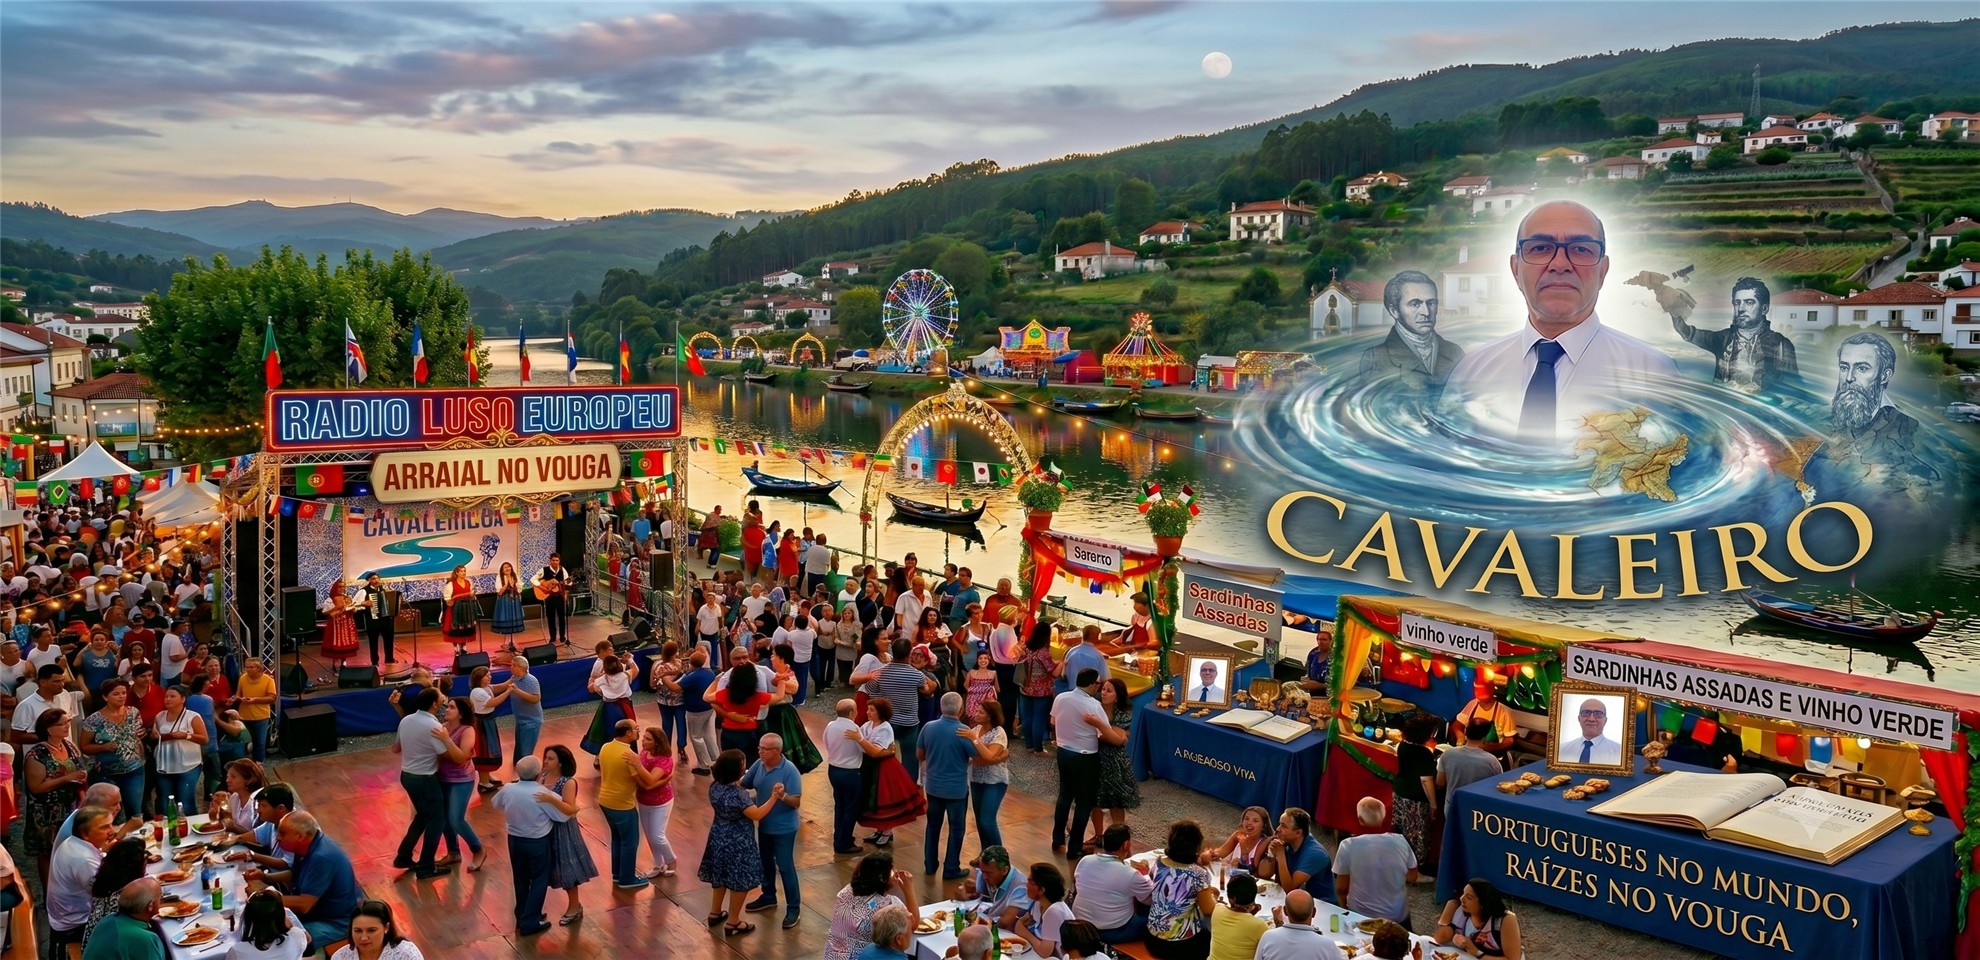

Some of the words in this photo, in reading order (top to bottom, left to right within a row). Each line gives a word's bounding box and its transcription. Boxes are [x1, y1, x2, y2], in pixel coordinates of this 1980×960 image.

[282, 398, 409, 440] RADIO
[422, 396, 515, 435] LUSO
[522, 394, 671, 432] EUROPEU
[384, 459, 491, 491] ARRAIAL
[498, 457, 529, 484] NO
[536, 453, 612, 482] VOUGA
[1189, 582, 1276, 615] Sardinhas
[1194, 601, 1268, 633] Assadas
[1406, 622, 1445, 644] vinho
[1448, 635, 1488, 653] verde
[1573, 654, 1677, 691] SARDINHAS
[1682, 675, 1773, 709] ASSADAS
[1780, 692, 1792, 713] E
[1798, 694, 1863, 725] VINHO
[1869, 707, 1944, 741] VERDE
[1174, 746, 1183, 758] A
[1472, 809, 1647, 872] PORTUGUESES
[1656, 853, 1704, 885] NO
[1712, 866, 1858, 928] MUNDO,
[1505, 851, 1598, 899] RAÍZES
[1607, 878, 1656, 913] NO
[1663, 893, 1794, 953] VOUGA
